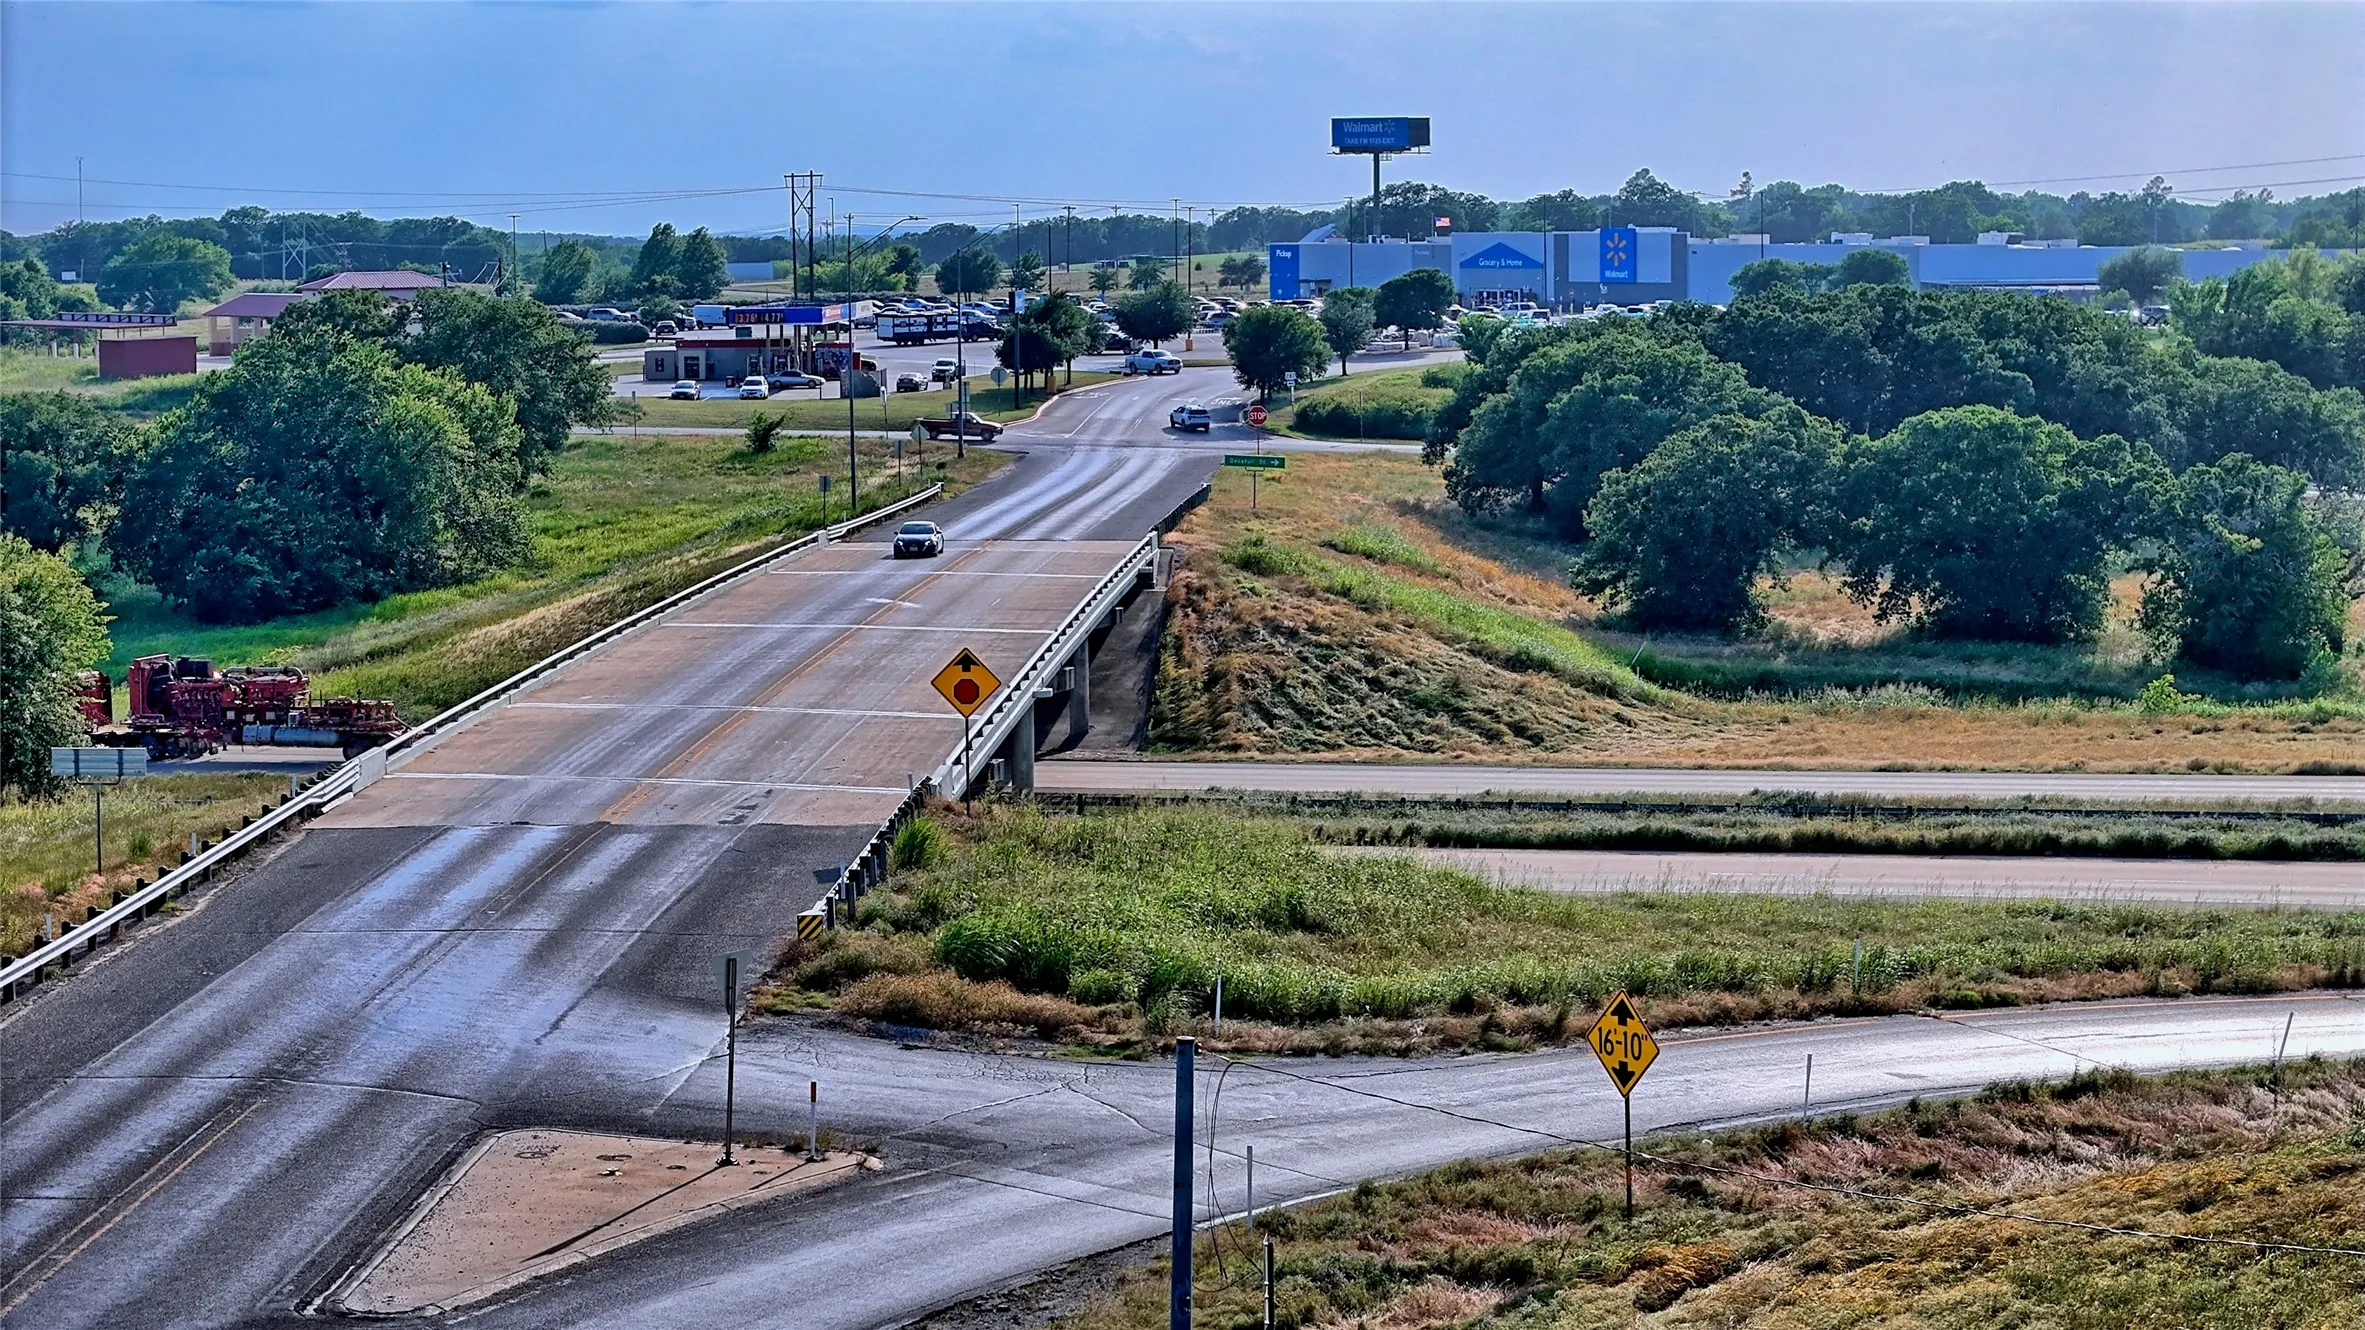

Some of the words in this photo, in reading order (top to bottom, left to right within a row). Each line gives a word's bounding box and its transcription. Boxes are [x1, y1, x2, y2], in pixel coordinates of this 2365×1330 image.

[1343, 121, 1383, 132] Walmart
[1276, 250, 1292, 259] Pickup
[1479, 258, 1499, 268] Grocery
[1605, 270, 1628, 278] Walmart
[1249, 412, 1266, 420] STOP
[1229, 457, 1254, 465] Decatur
[1597, 1026, 1648, 1061] 16'-10"
